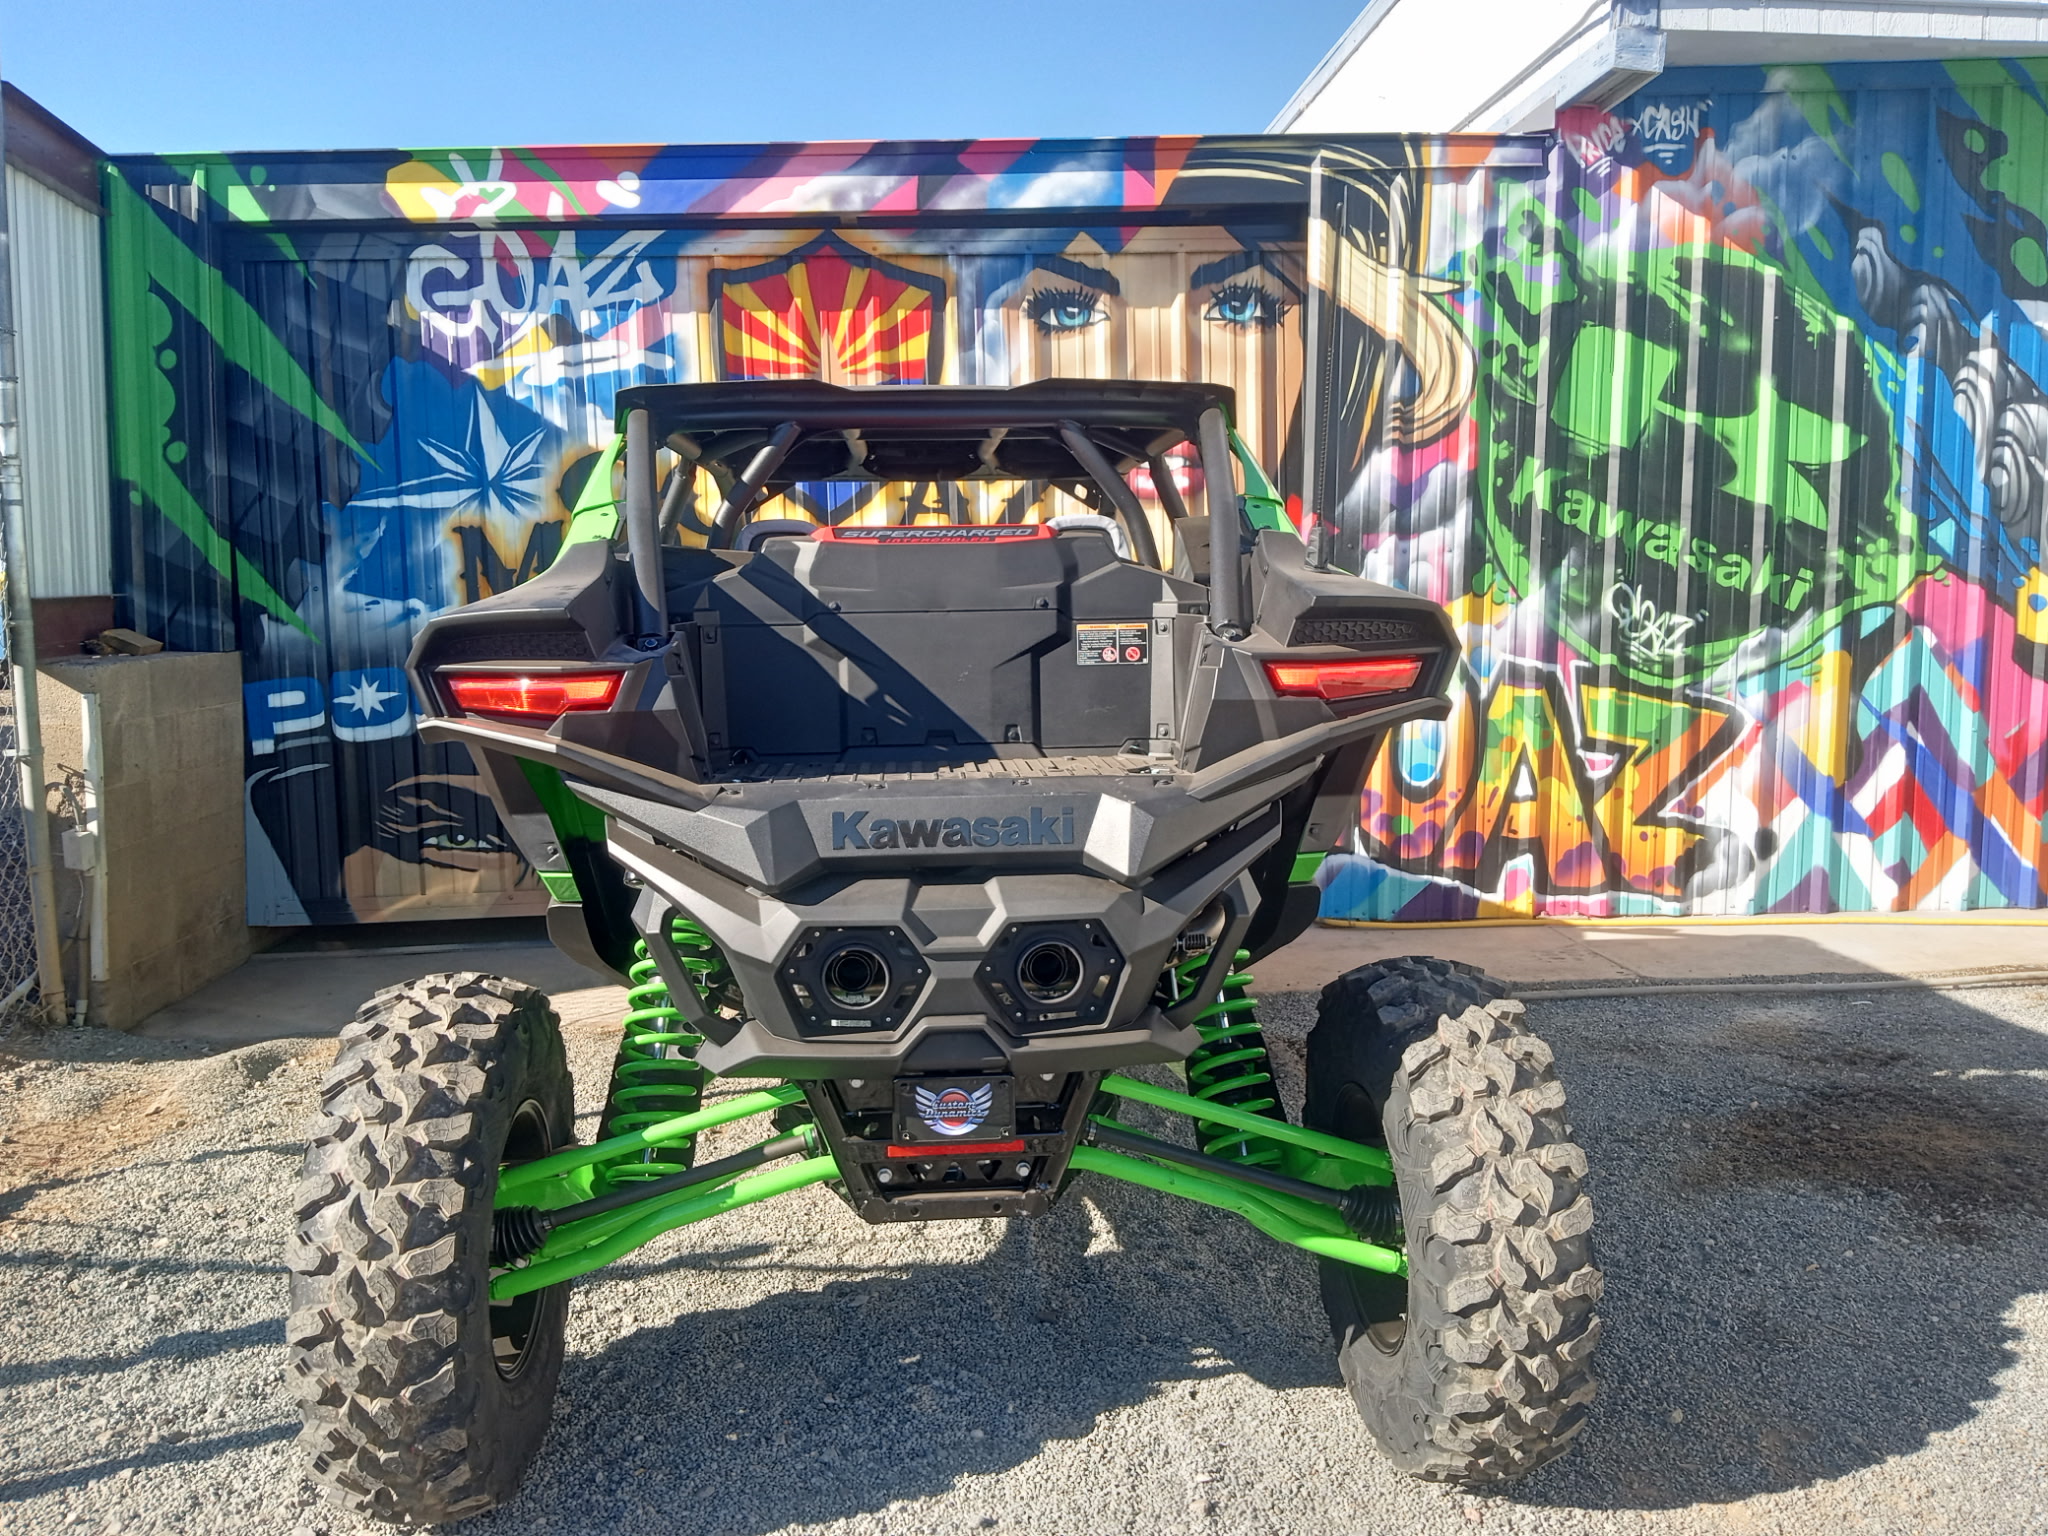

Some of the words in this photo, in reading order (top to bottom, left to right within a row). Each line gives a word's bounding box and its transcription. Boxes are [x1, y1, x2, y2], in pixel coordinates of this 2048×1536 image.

[841, 527, 1033, 539] SUPERCHARGED
[243, 667, 424, 756] PO
[831, 806, 1075, 851] Kawasaki
[931, 1100, 977, 1110] Custom
[925, 1108, 985, 1119] Dynamics
